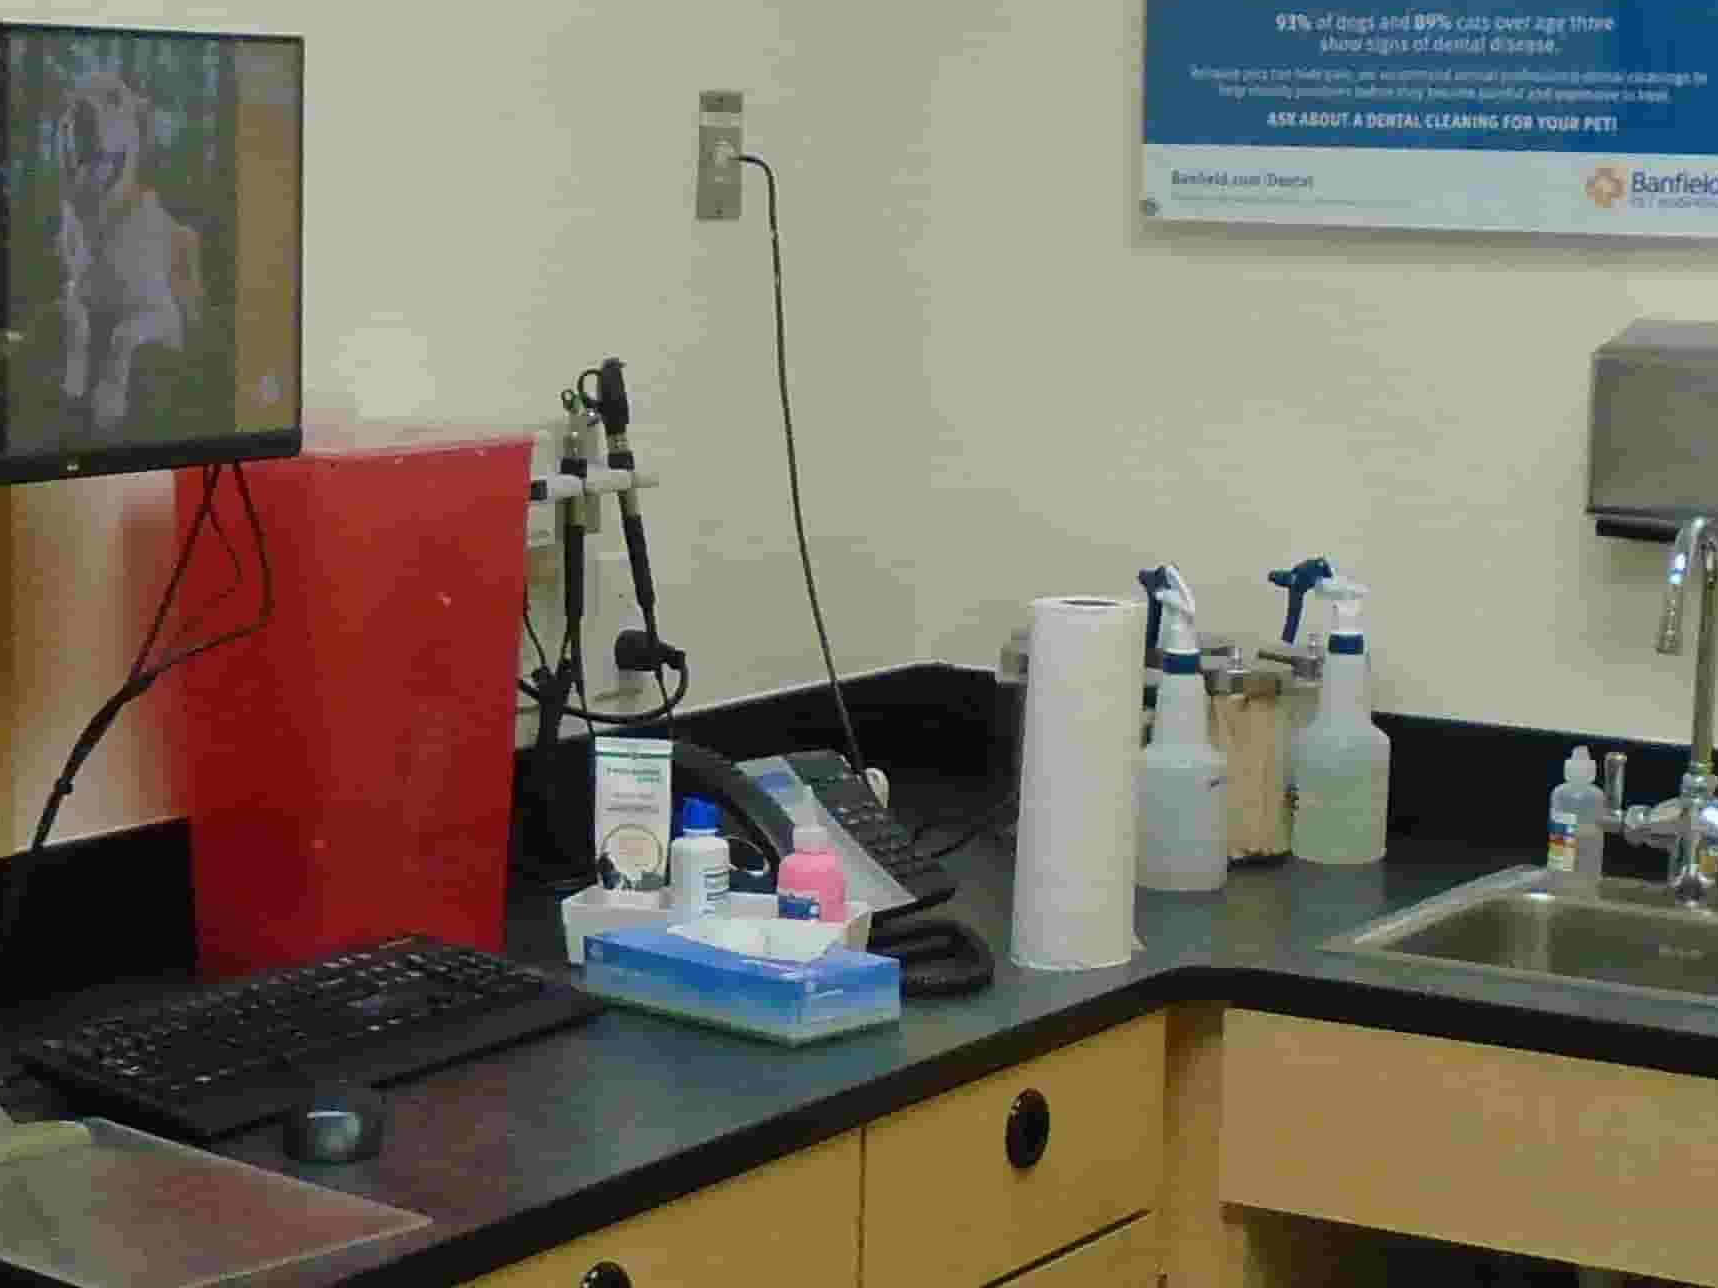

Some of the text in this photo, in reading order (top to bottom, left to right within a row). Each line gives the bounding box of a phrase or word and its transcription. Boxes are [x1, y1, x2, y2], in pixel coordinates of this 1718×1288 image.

[1299, 112, 1347, 128] ABOUT
[1367, 113, 1421, 129] DENTAL
[1425, 114, 1500, 130] CLEANING
[1503, 115, 1533, 131] FOR
[1537, 116, 1580, 132] YOUR
